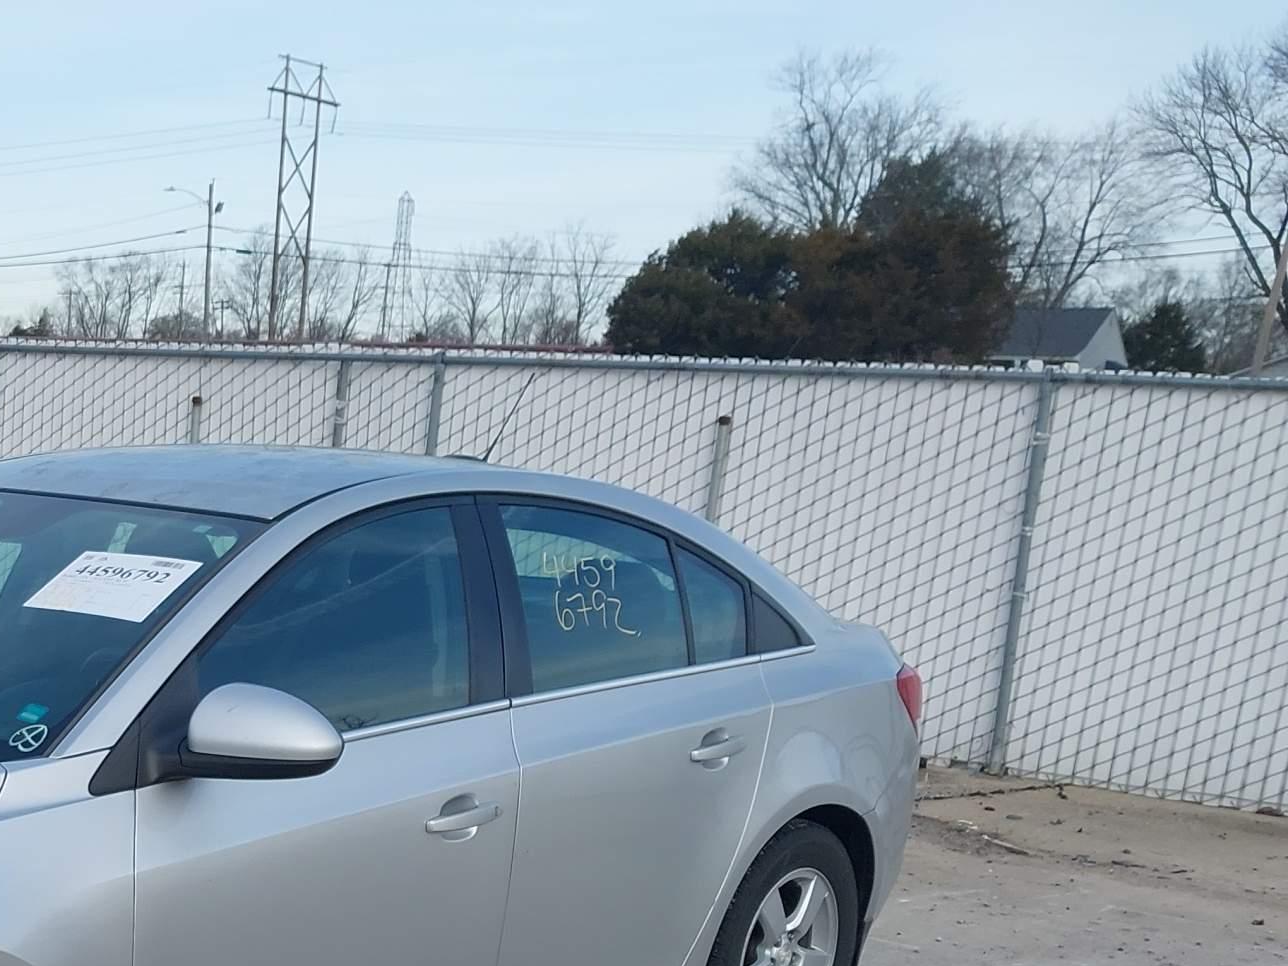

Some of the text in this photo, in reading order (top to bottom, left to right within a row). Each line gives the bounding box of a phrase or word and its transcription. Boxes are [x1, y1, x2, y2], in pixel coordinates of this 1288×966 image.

[74, 564, 171, 584] 44596792
[543, 551, 616, 590] 4459
[555, 589, 641, 636] 6792
